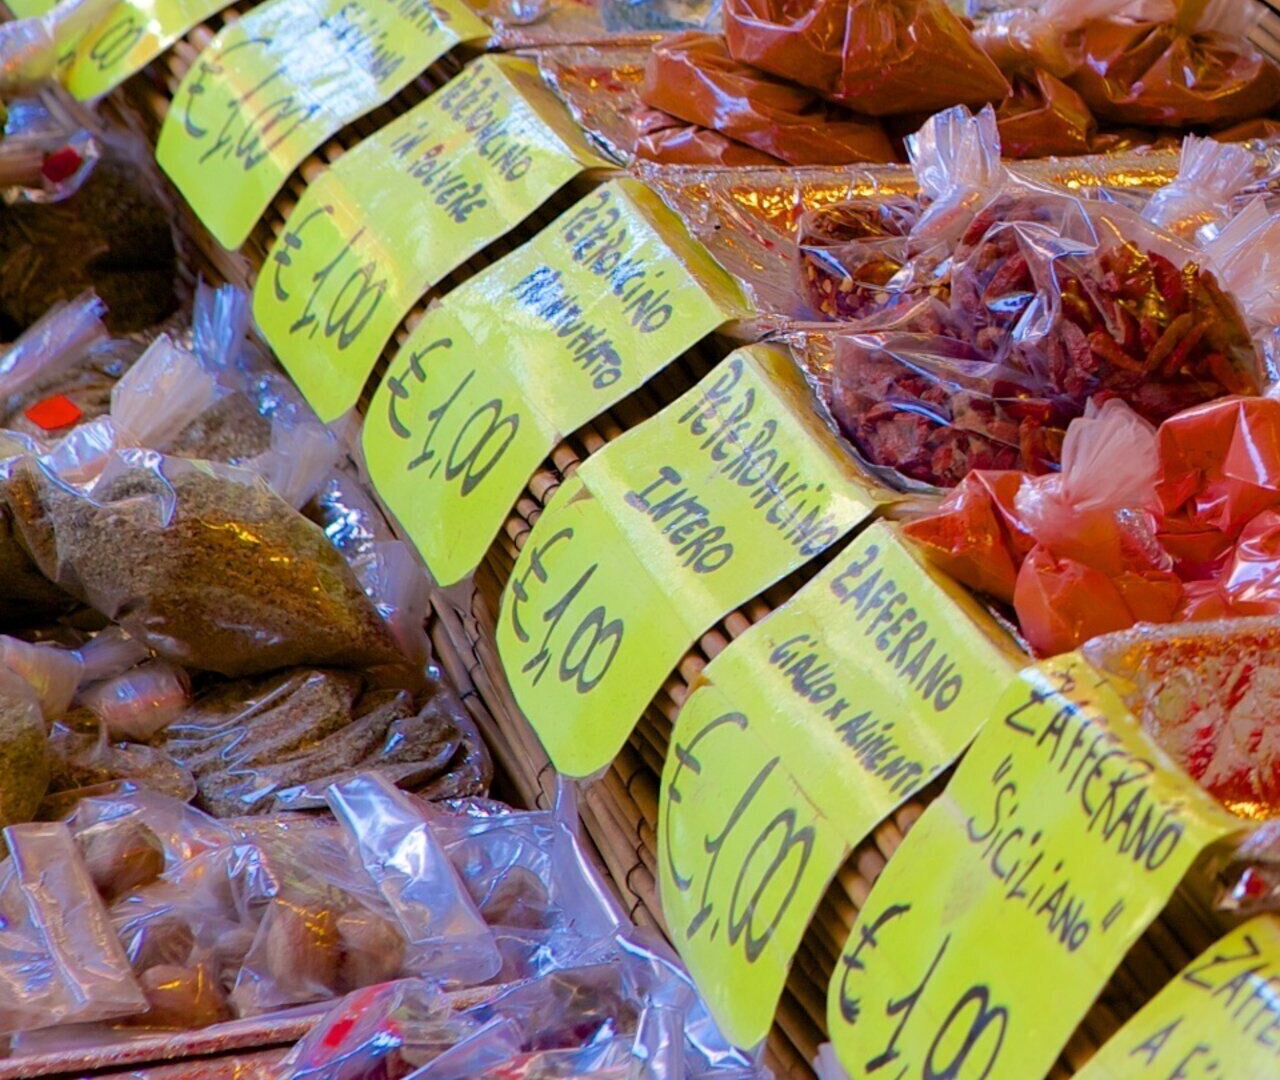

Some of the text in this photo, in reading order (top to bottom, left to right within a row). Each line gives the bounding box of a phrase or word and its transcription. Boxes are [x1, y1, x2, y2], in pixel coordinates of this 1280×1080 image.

[407, 142, 489, 225] POLVERE
[624, 465, 735, 576] INTERO
[830, 544, 964, 712] ZAFFERANO
